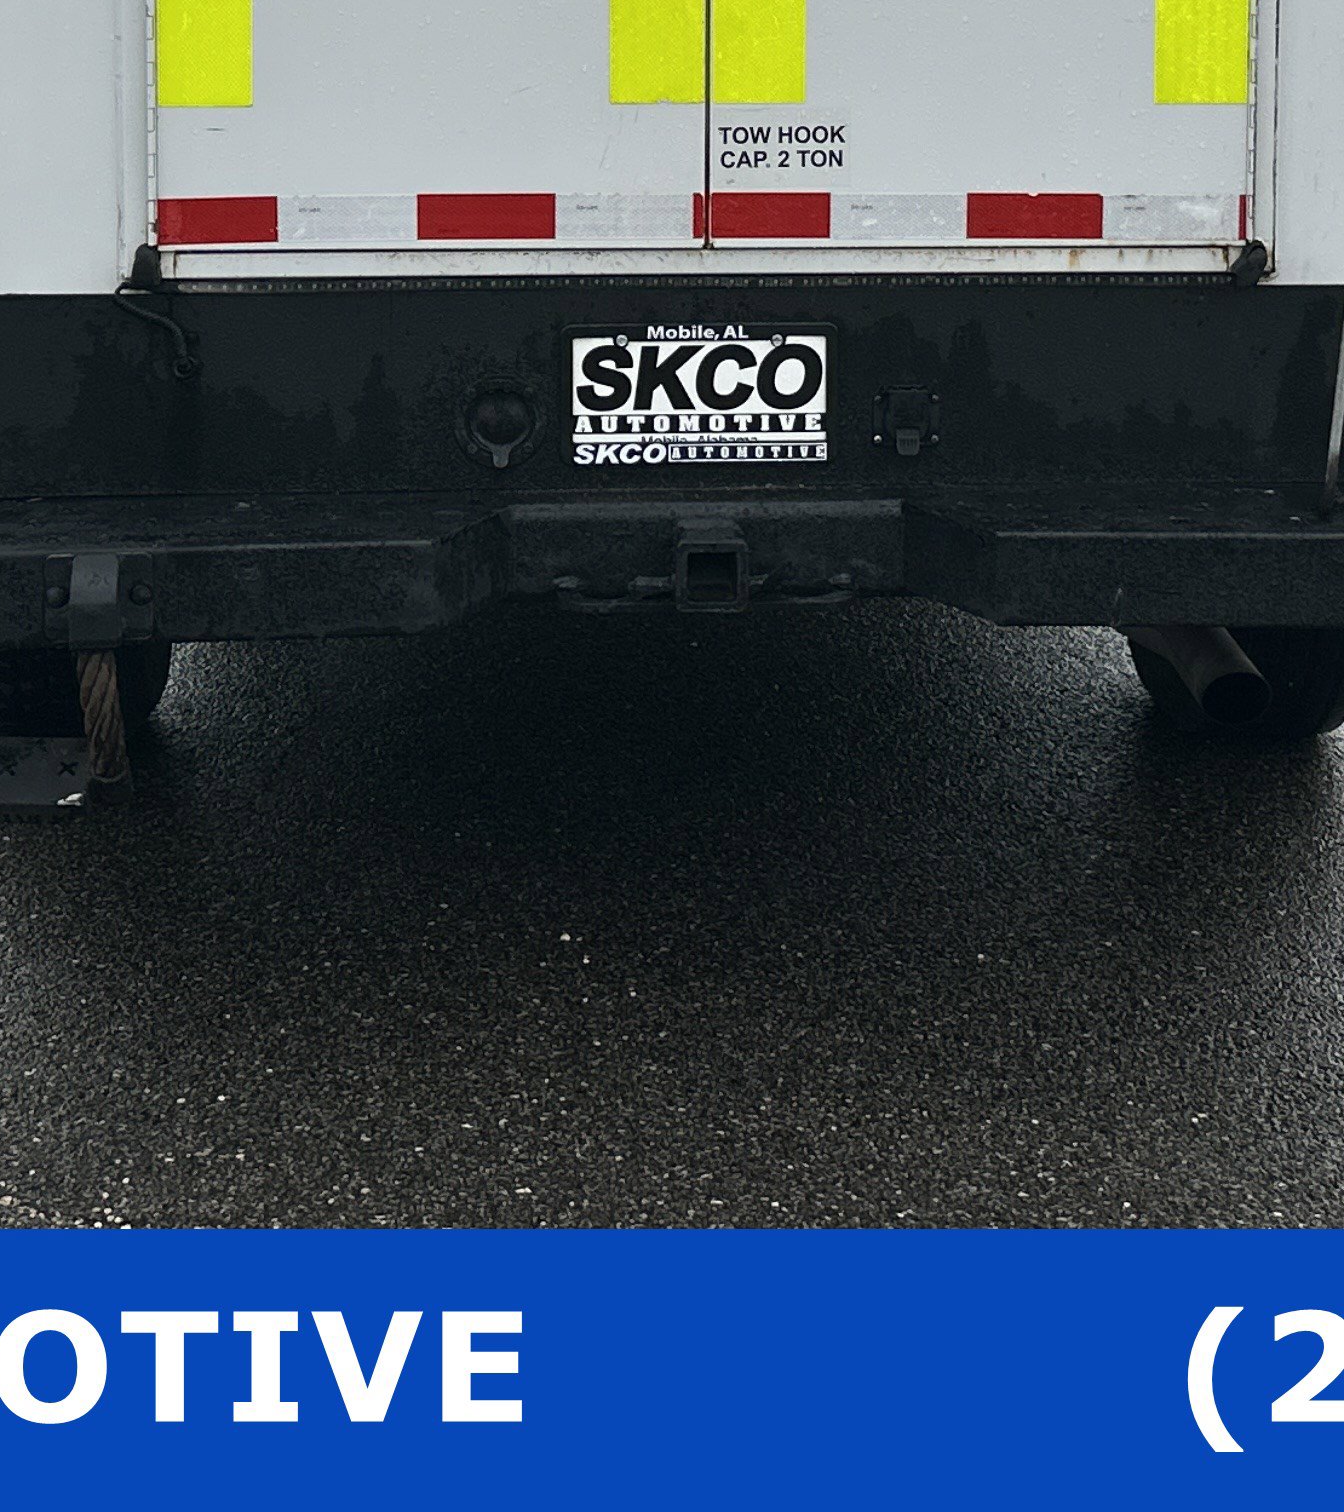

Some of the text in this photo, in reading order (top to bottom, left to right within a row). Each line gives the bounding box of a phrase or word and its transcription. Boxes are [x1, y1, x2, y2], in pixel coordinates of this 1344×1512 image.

[718, 125, 846, 144] TOW HOOK
[720, 149, 843, 168] CAP. 2 TON
[647, 325, 749, 340] Mobile, AL
[576, 343, 823, 412] SKCO
[575, 414, 822, 433] AUTOMOTIVE
[573, 443, 826, 465] SKCO AUTOMOTIVE
